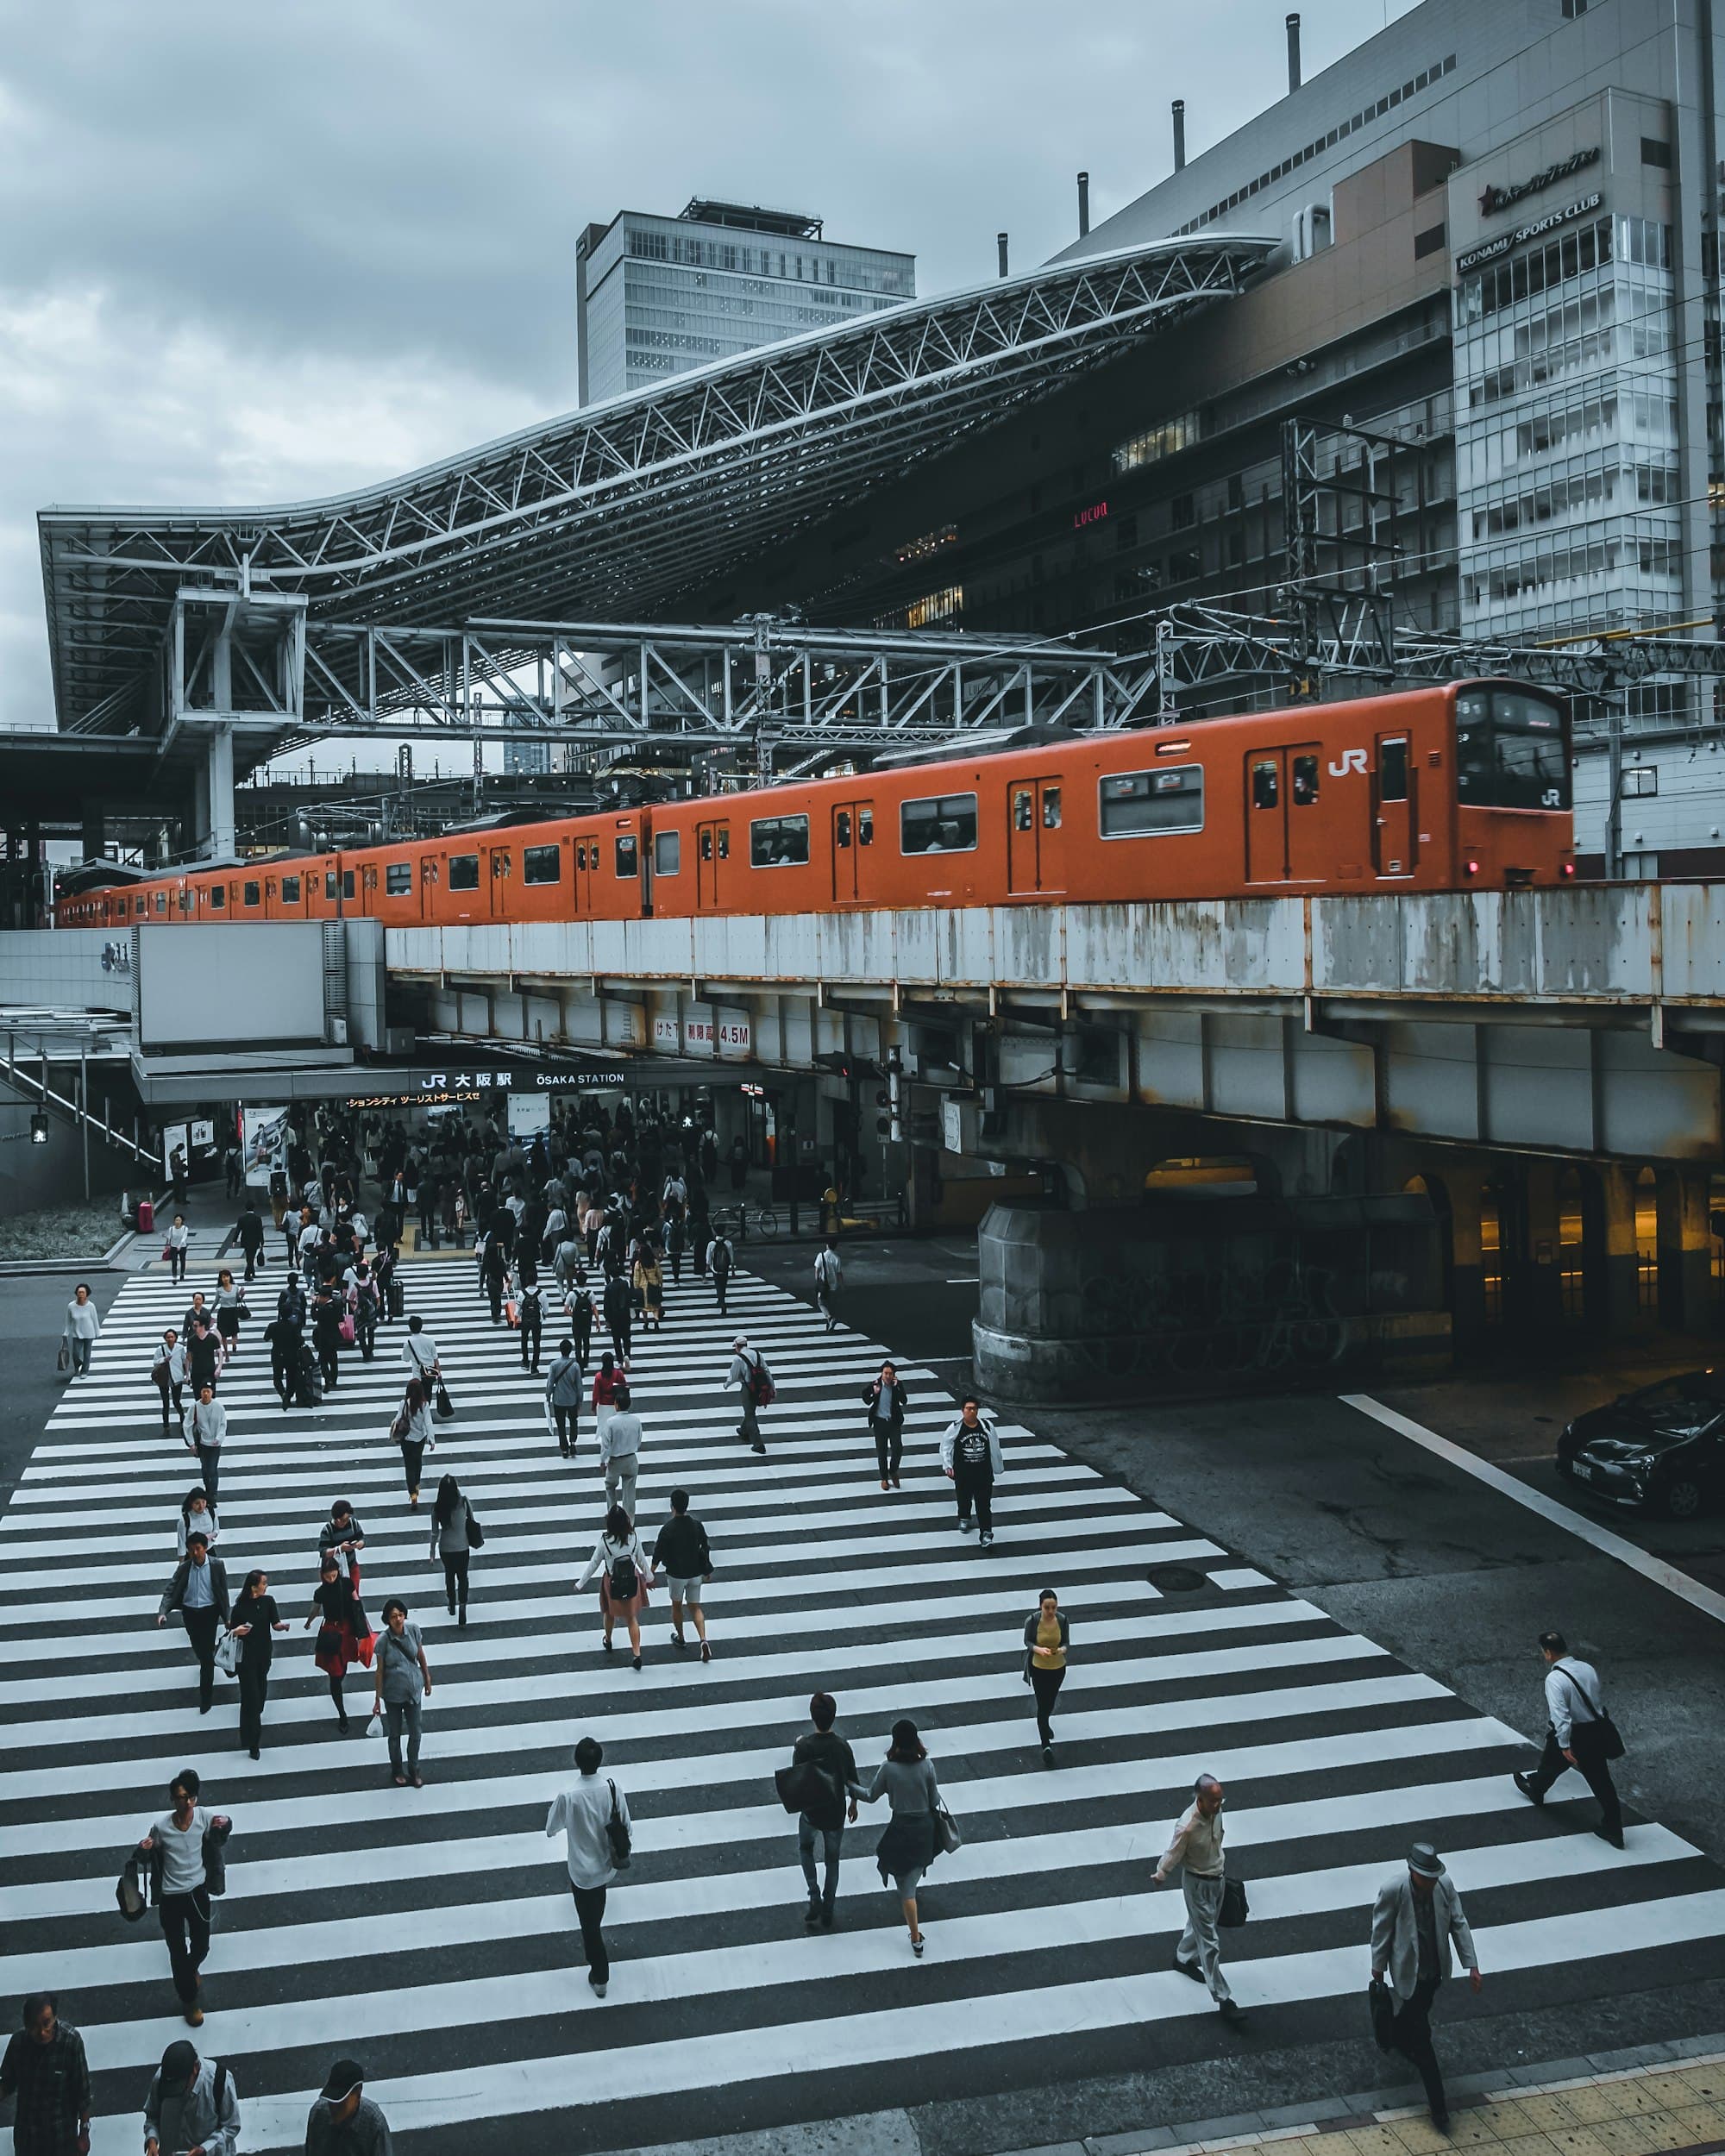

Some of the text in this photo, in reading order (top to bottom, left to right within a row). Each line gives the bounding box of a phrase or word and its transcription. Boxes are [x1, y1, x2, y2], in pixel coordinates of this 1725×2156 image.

[1459, 193, 1600, 269] KONAMI SPORTS CLUB
[1328, 749, 1367, 776] JR
[1541, 788, 1560, 806] JR
[721, 1025, 748, 1044] 4.5M
[422, 1072, 511, 1088] JR 大阪駅
[578, 1074, 624, 1084] STATION
